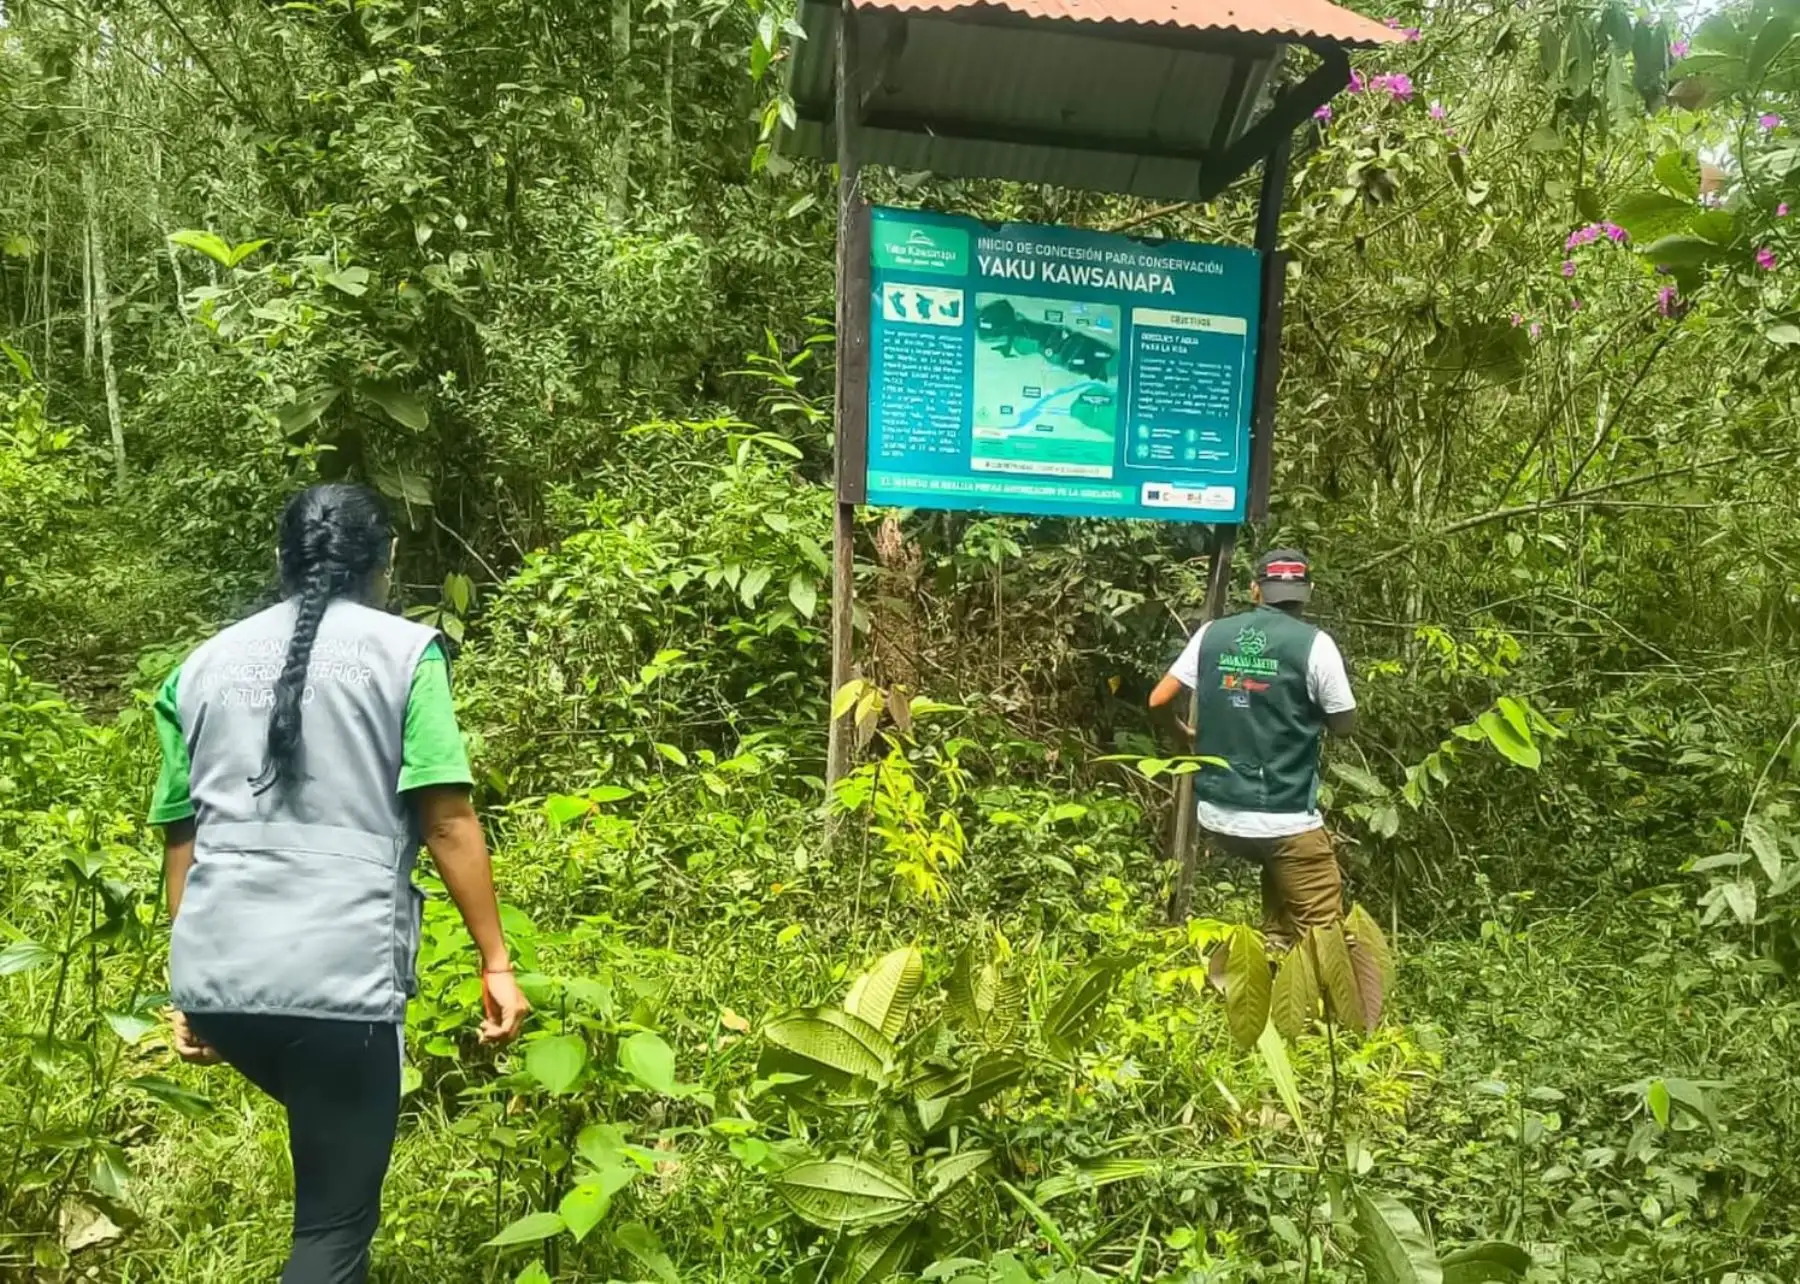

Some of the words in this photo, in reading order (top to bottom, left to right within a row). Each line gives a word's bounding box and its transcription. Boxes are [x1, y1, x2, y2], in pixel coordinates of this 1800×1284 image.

[977, 238, 1014, 252] INICIO
[1016, 242, 1032, 254] DE
[1035, 244, 1102, 262] CONCESIÓN
[1105, 251, 1136, 266] PARA
[1138, 255, 1224, 275] CONSERVACIÓN
[977, 255, 1036, 281] YAKU
[1041, 262, 1176, 295] KAWSANAPA
